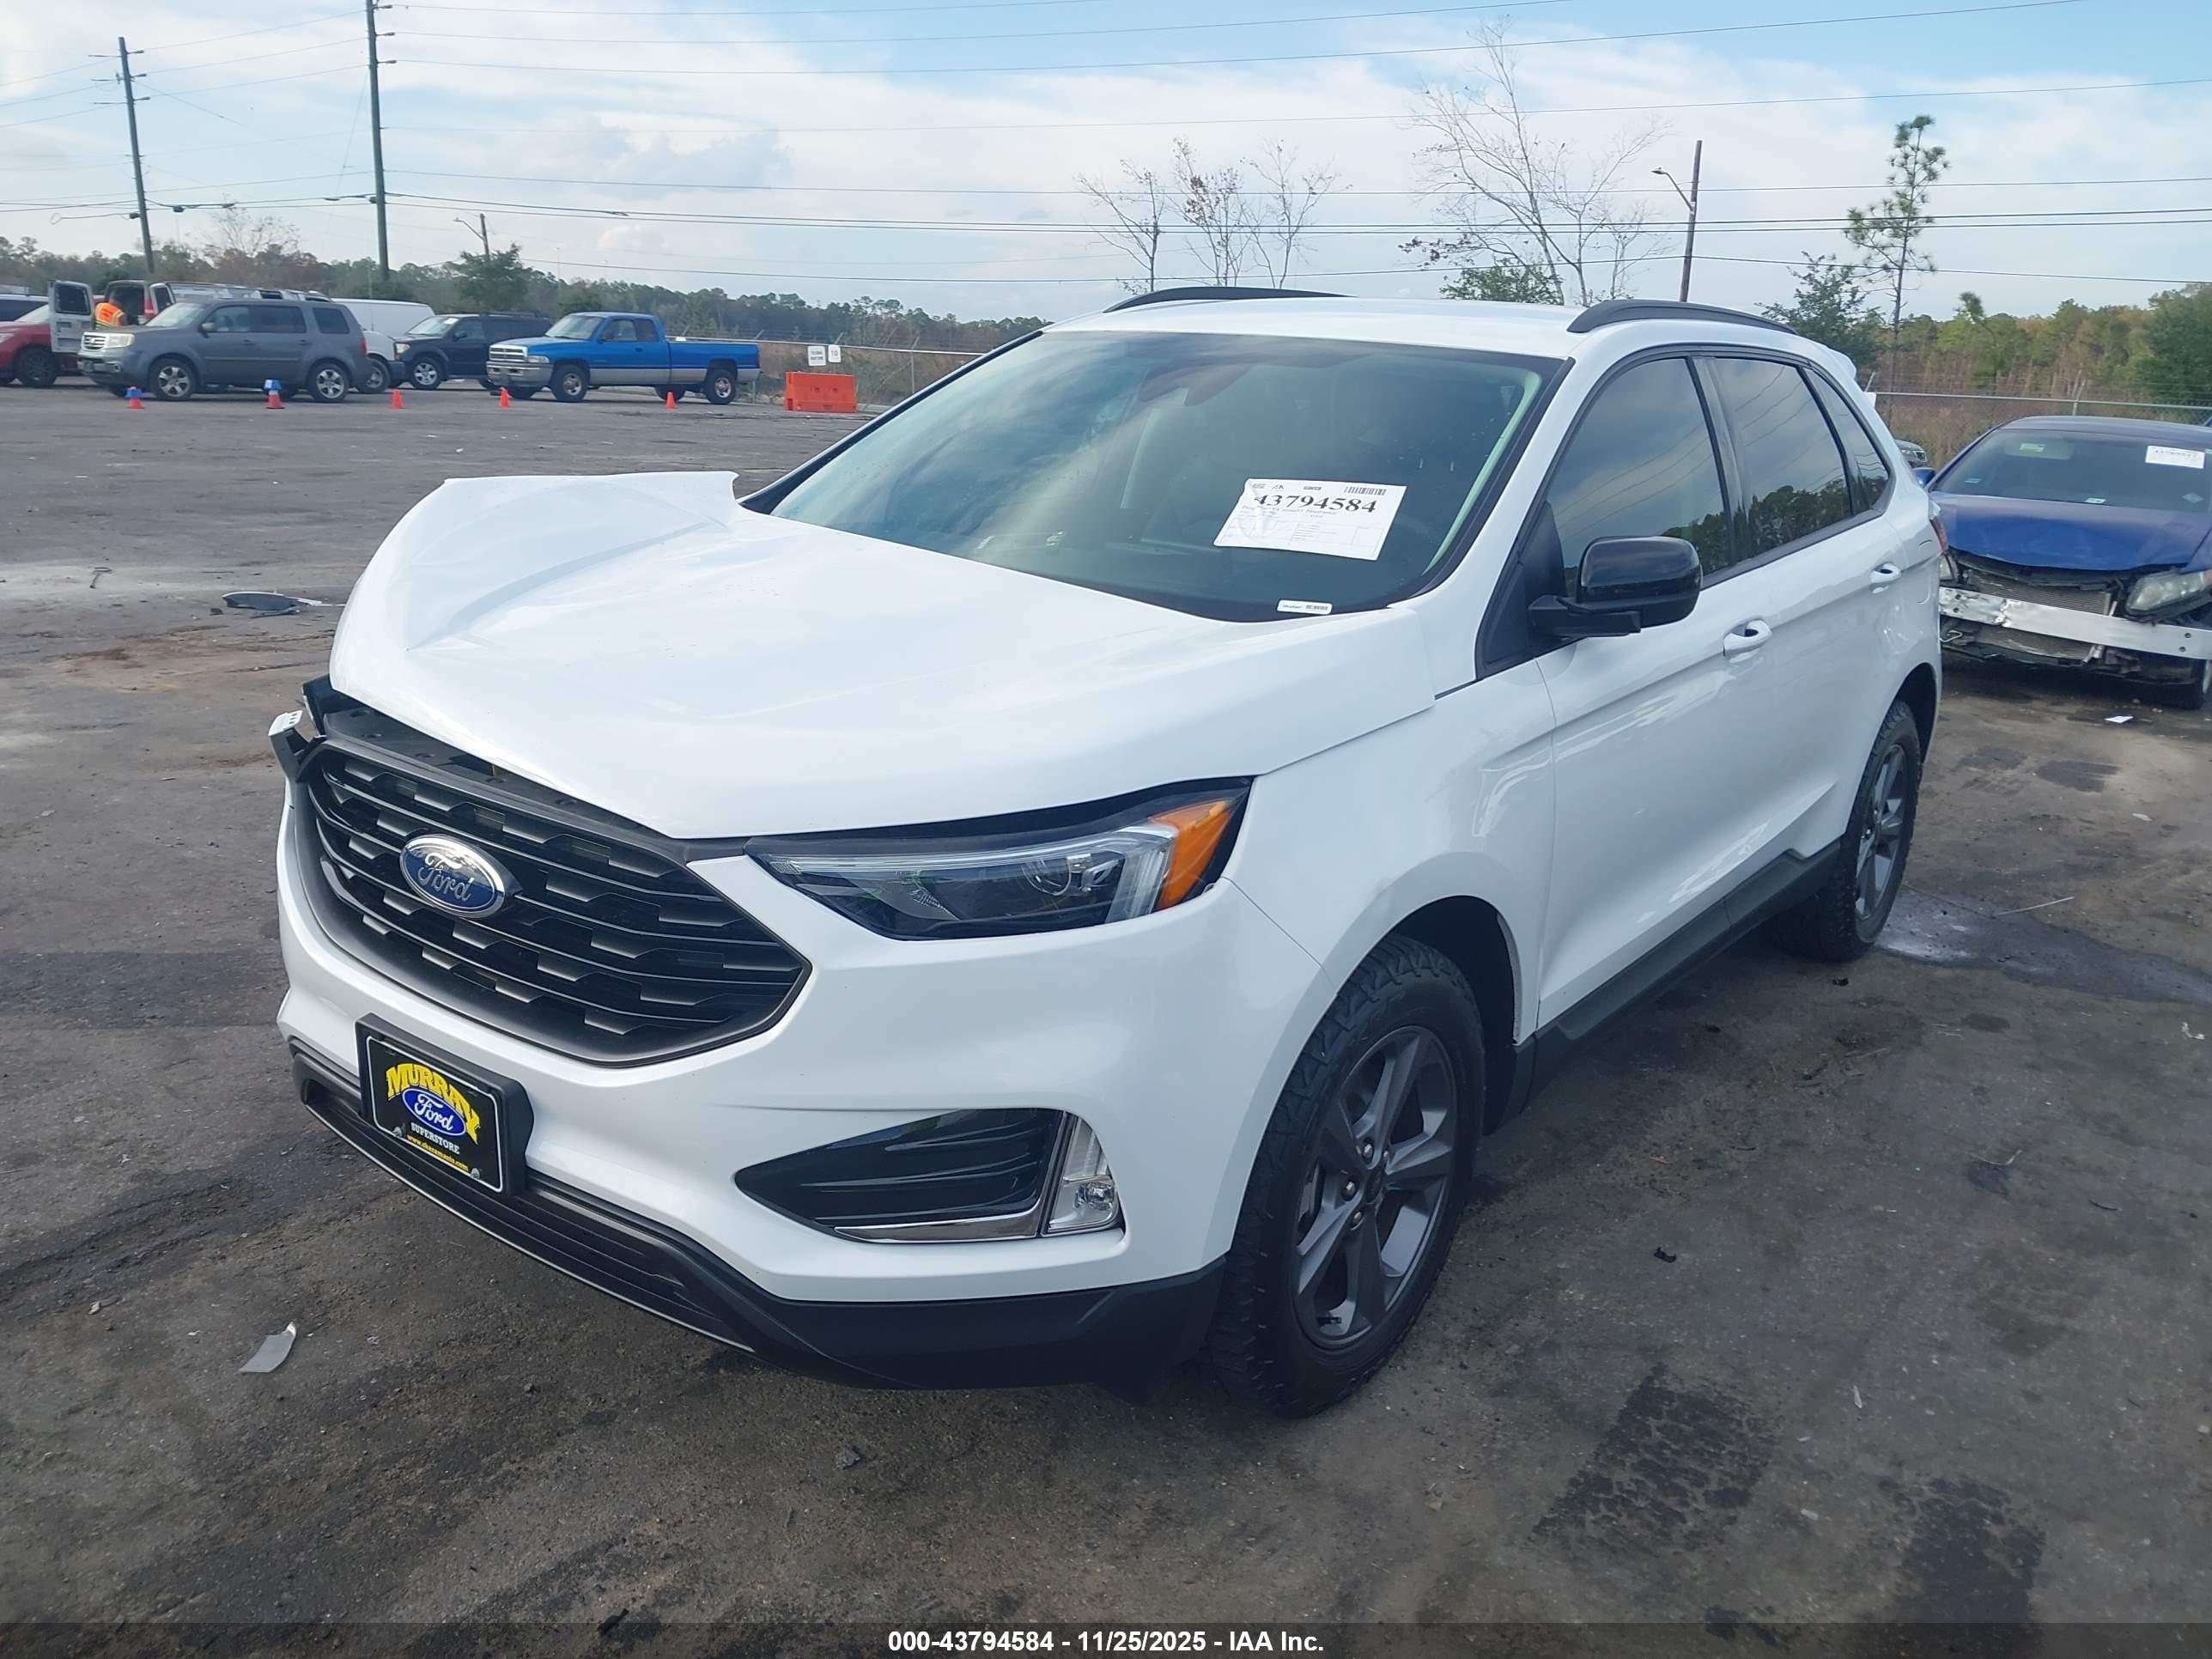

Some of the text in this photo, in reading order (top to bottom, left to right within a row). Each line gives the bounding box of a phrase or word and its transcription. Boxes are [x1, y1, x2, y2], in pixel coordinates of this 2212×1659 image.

[1254, 494, 1377, 513] 43794584
[417, 852, 475, 902] Ford
[386, 1063, 480, 1145] MURRAY
[414, 1093, 453, 1131] Ford
[410, 1121, 460, 1155] SUPERSTORE
